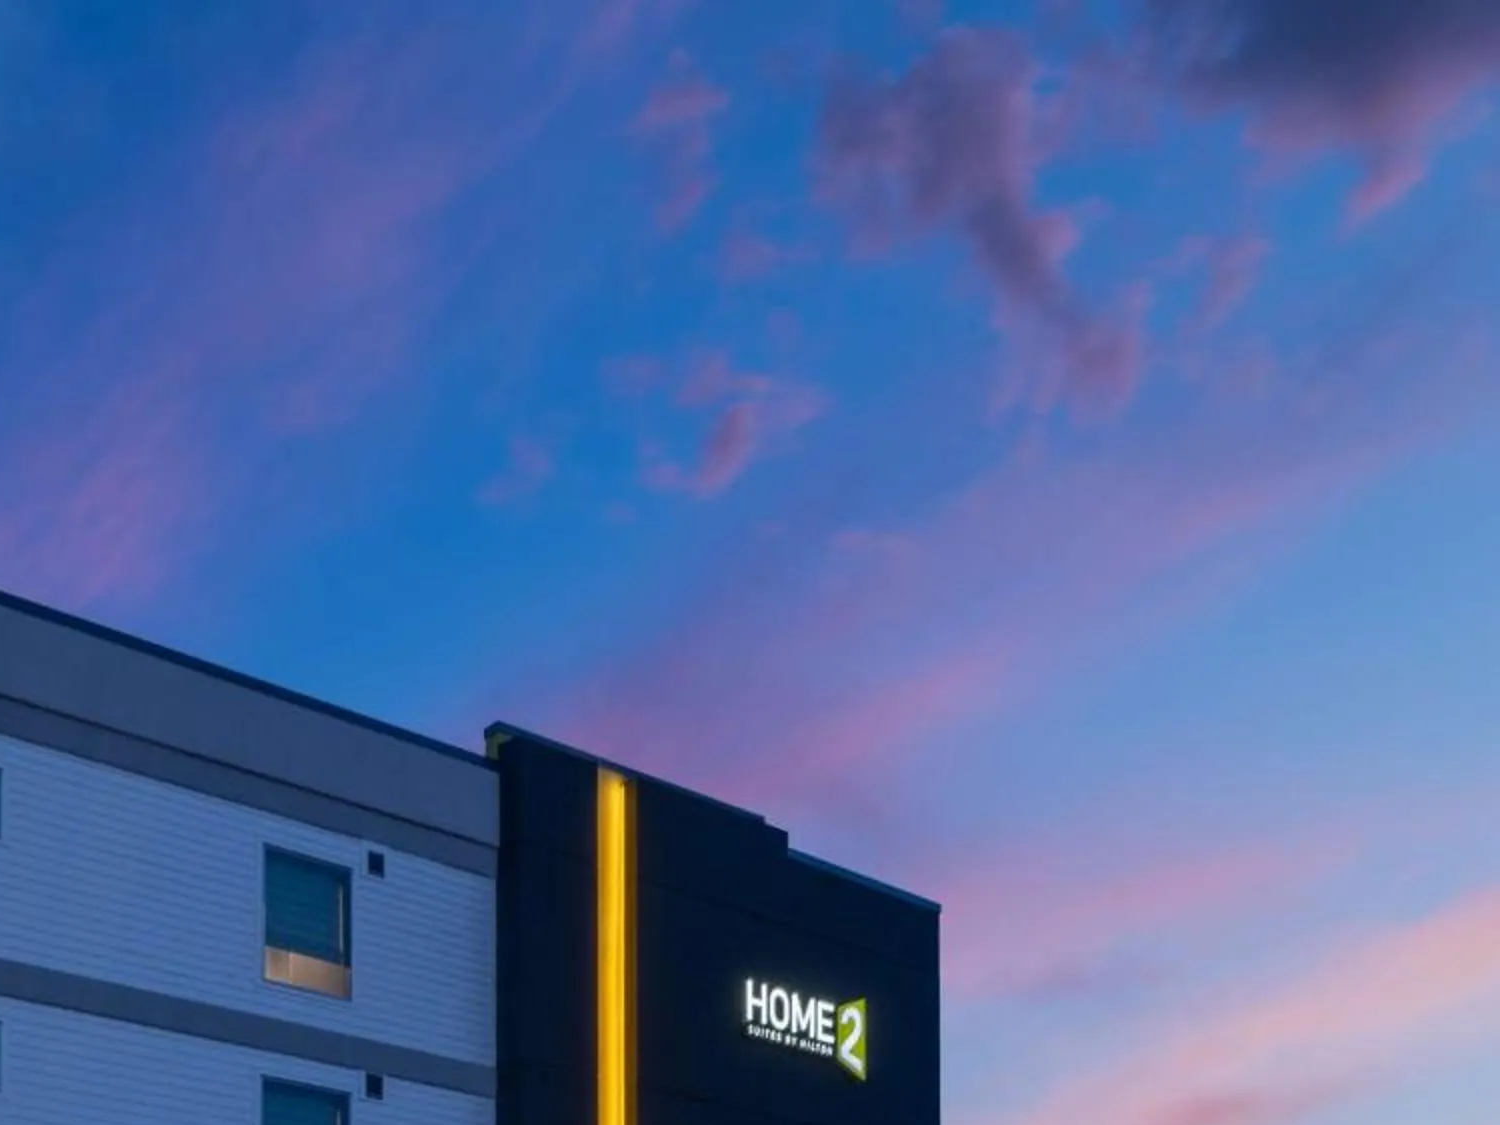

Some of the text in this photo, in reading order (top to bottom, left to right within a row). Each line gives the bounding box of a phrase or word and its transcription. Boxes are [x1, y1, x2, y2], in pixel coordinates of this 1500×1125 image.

[745, 978, 863, 1072] HOME 2
[747, 1023, 834, 1058] SUITES BY HILTON
